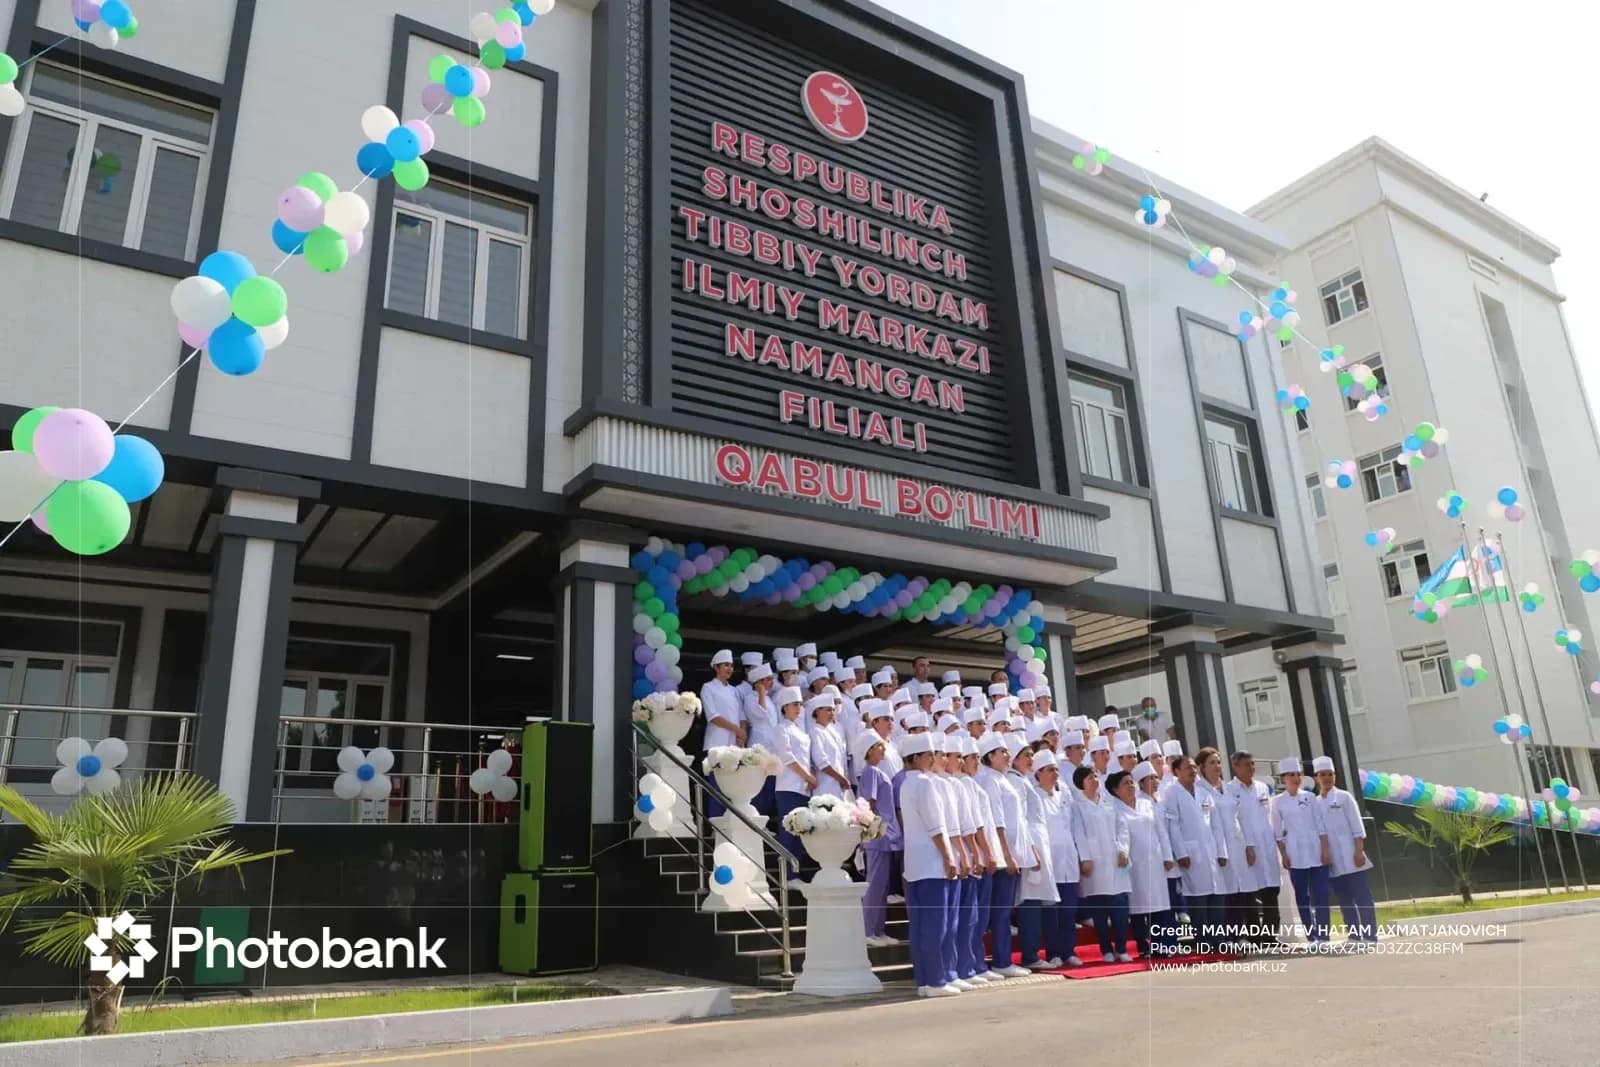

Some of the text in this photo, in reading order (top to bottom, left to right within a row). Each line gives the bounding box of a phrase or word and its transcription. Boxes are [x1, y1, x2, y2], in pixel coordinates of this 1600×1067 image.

[703, 166, 968, 281] SHOSHILINCH
[711, 121, 953, 235] RESPUBLIKA
[679, 206, 989, 330] TIBBIY YORDAM
[682, 258, 991, 375] ILMIY MARKAZI
[725, 323, 965, 413] NAMANGAN
[778, 390, 928, 453] FILIALI
[714, 444, 882, 511] QABUL
